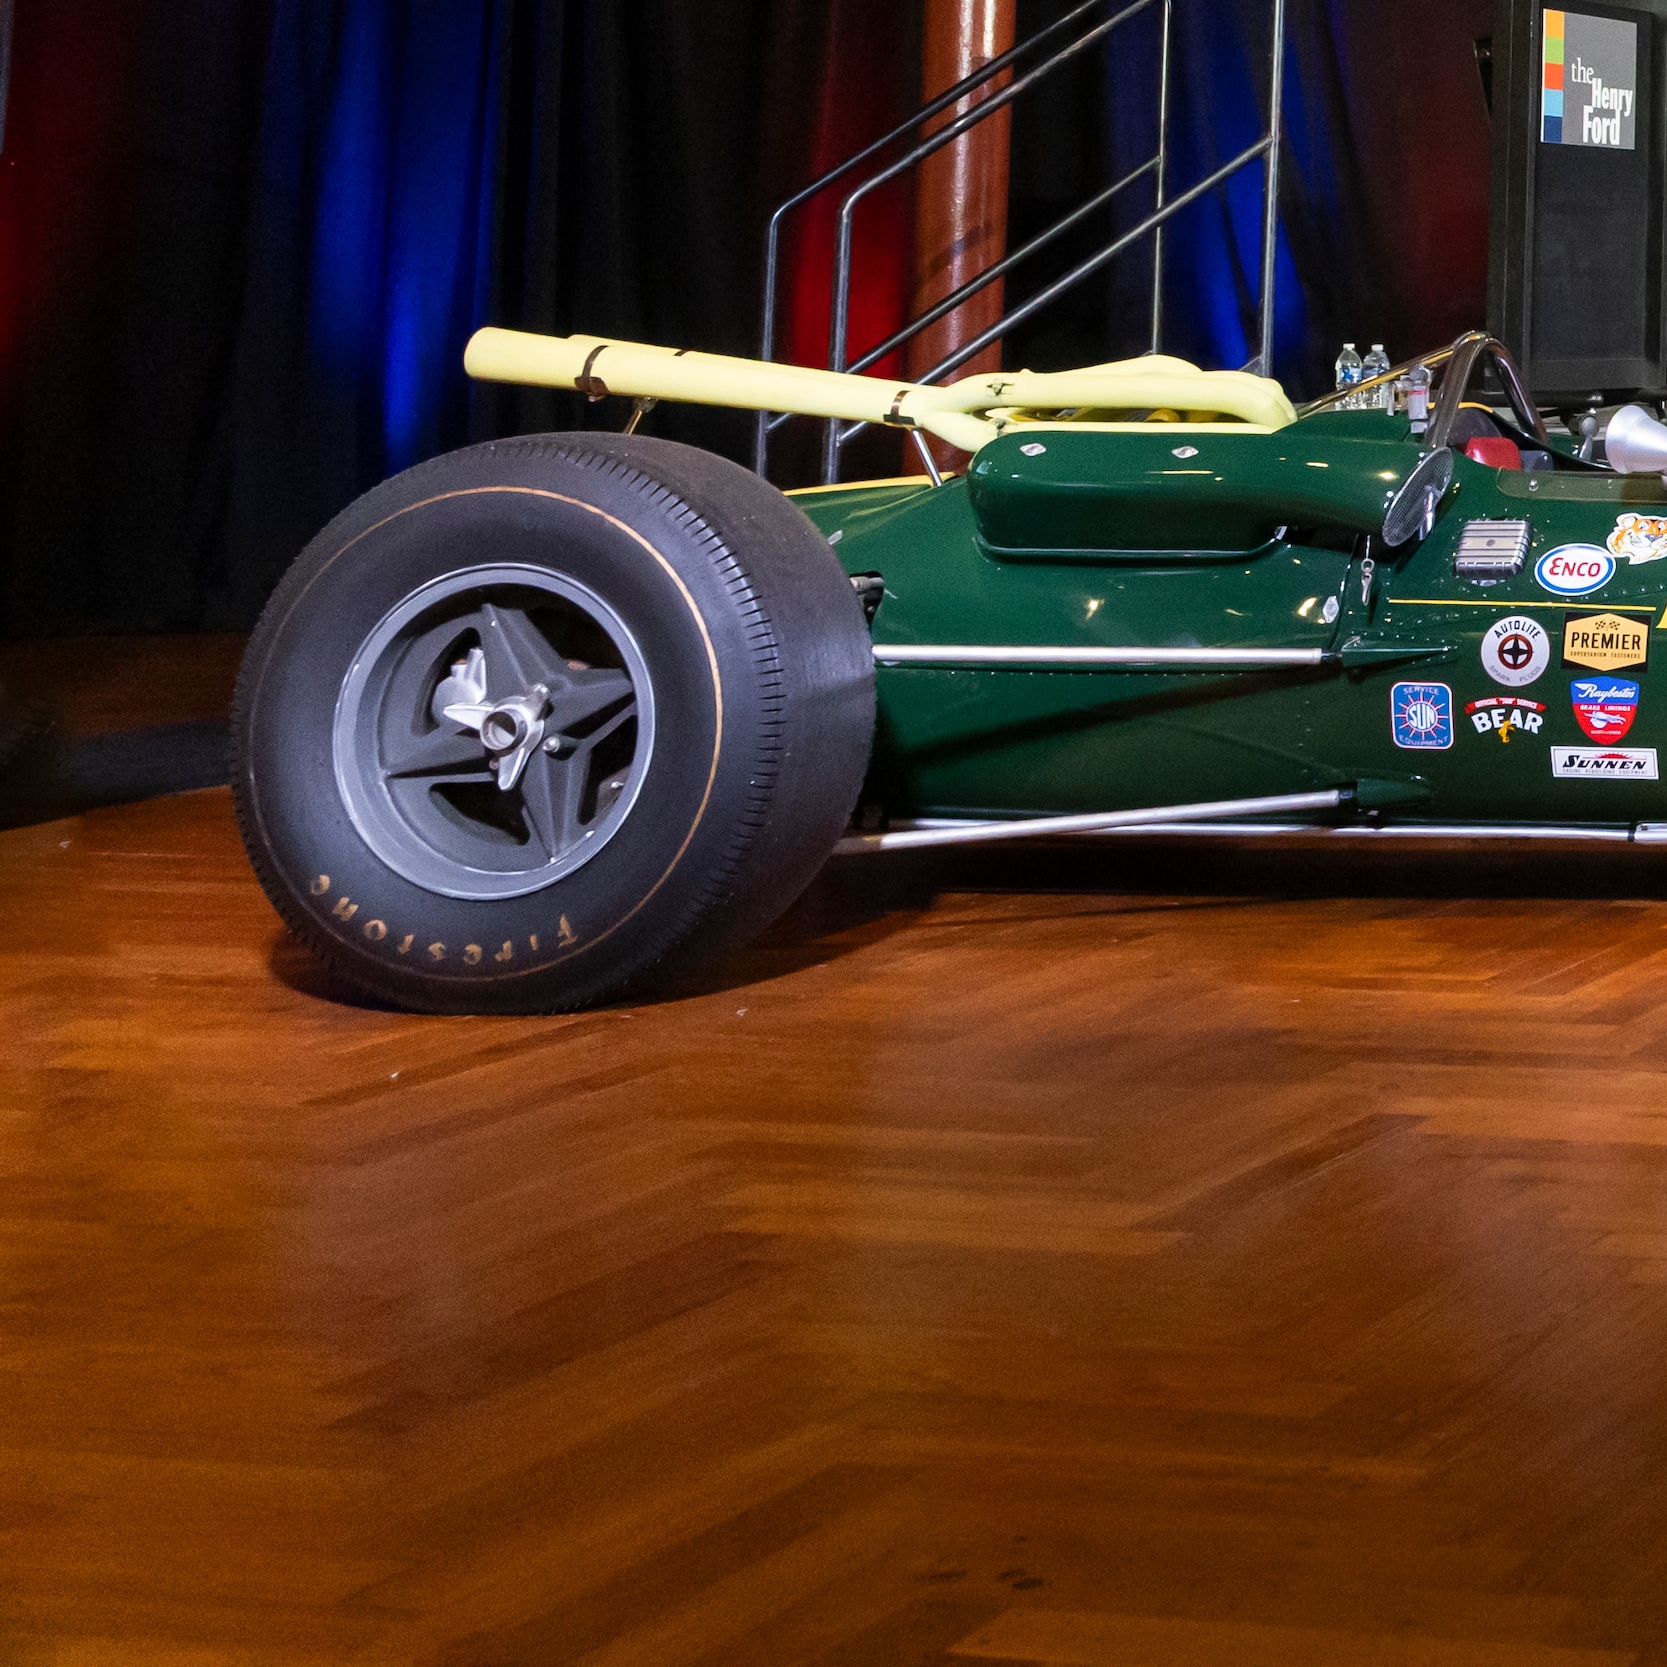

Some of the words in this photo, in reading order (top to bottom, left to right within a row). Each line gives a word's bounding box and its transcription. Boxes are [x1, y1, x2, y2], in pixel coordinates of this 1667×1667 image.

[1571, 57, 1594, 83] the
[1591, 78, 1633, 117] Henry
[1583, 105, 1621, 145] Ford
[1549, 557, 1601, 577] ENCO
[1494, 620, 1540, 640] AUTOLITE
[1571, 632, 1641, 650] PREMIER
[1489, 665, 1512, 683] SPARK
[1519, 665, 1542, 683] PLUGS
[1403, 686, 1439, 695] SERVICE
[1575, 683, 1635, 702] Raybestos
[1516, 698, 1538, 710] SERVICE
[1408, 703, 1436, 730] SUN
[1471, 708, 1543, 735] BEAR
[1398, 735, 1449, 746] EQUIPMENT
[1563, 755, 1647, 769] SUNNEN
